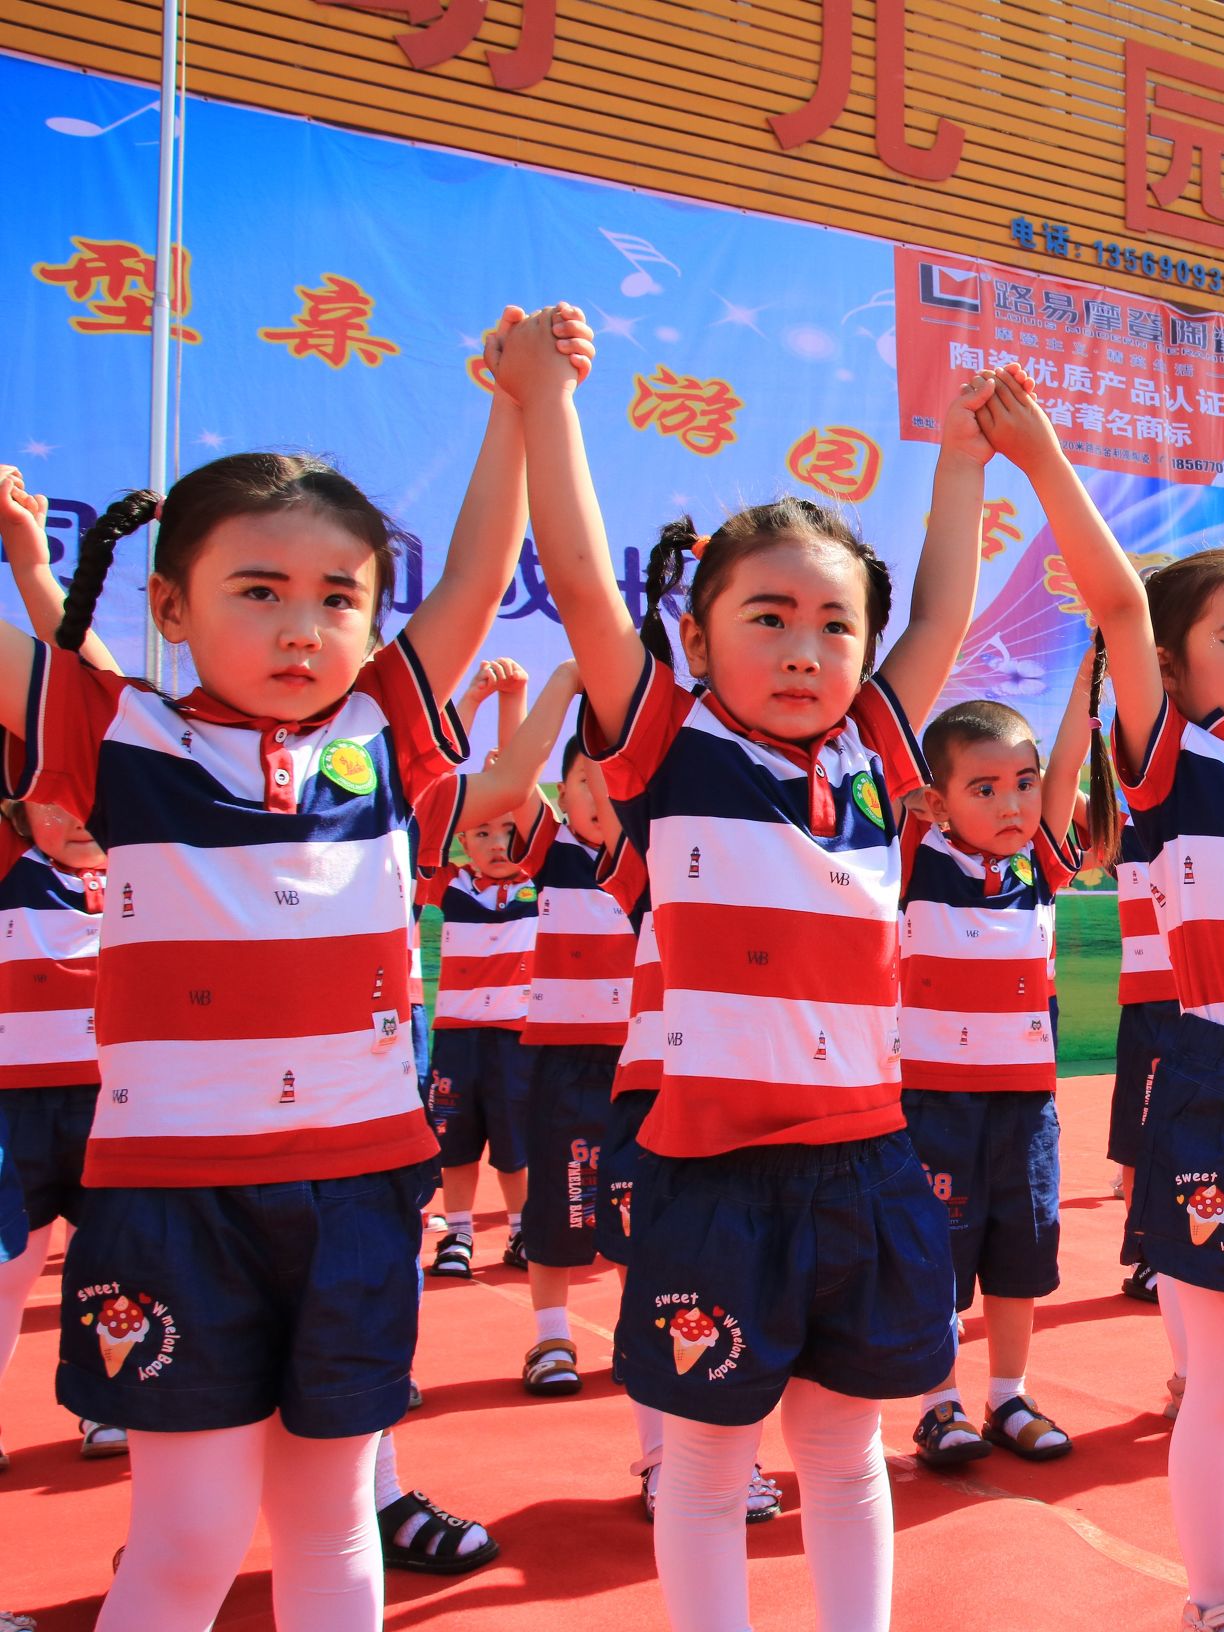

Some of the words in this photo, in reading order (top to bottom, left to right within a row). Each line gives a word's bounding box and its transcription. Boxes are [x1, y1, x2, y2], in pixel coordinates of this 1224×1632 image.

[995, 310, 1057, 331] LOUIS
[1066, 325, 1148, 349] MODERN
[1035, 398, 1193, 449] 省著名商标
[829, 871, 850, 886] WB
[274, 890, 300, 906] WB
[965, 929, 980, 938] WB
[748, 951, 769, 966] WB
[188, 989, 212, 1006] WB
[667, 1032, 683, 1046] WB
[112, 1088, 129, 1104] WB
[568, 1160, 583, 1201] WMELON
[610, 1180, 633, 1192] swee
[1175, 1171, 1218, 1185] sweet
[569, 1202, 583, 1229] BABY
[78, 1281, 121, 1302] sweet
[655, 1292, 700, 1308] sweet
[138, 1353, 173, 1382] Baby
[708, 1359, 737, 1382] Baby
